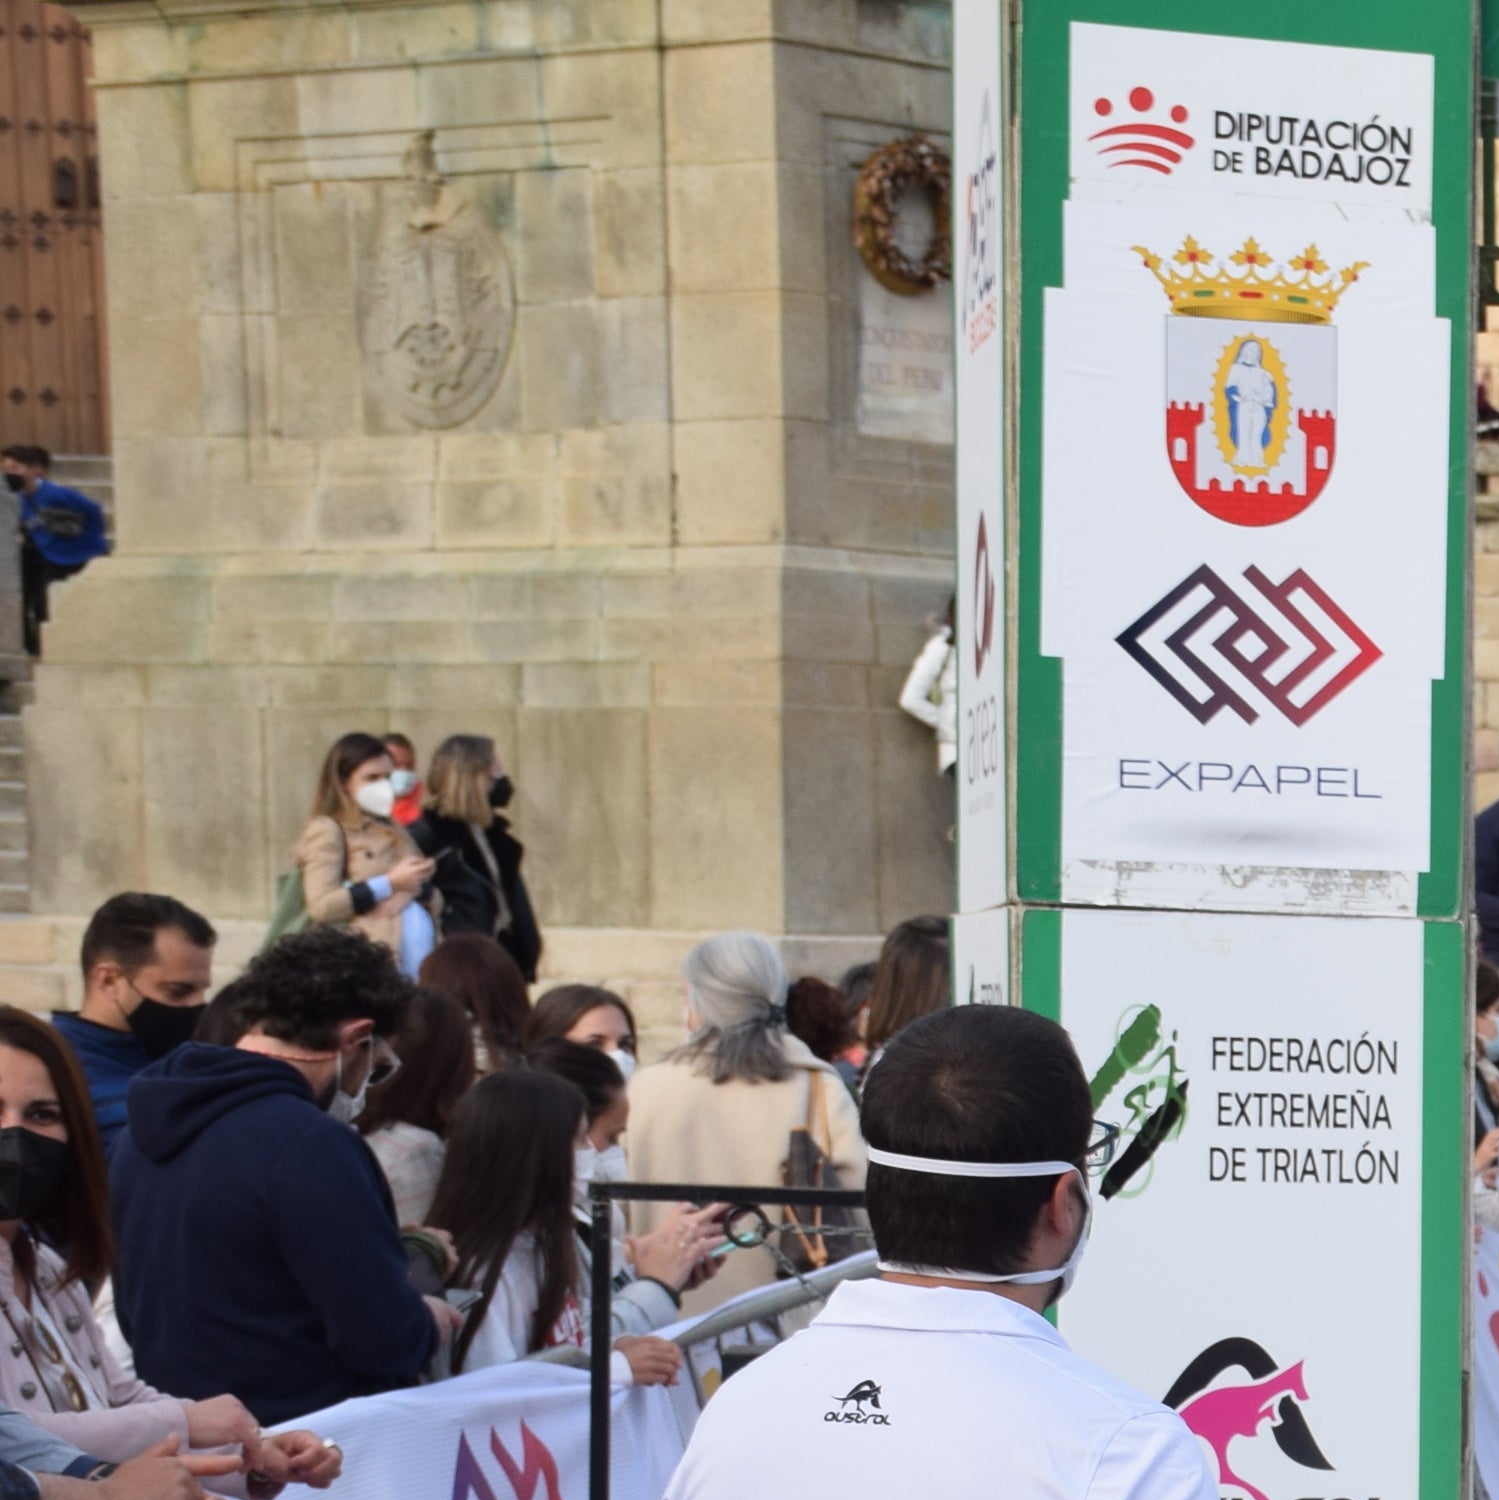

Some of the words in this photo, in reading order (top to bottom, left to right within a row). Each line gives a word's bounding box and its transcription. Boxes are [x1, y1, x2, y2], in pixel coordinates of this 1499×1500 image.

[1213, 110, 1413, 156] DIPUTACIÓN
[1213, 150, 1244, 175] DE
[1254, 147, 1411, 188] BADAJOZ
[967, 694, 998, 786] area
[1118, 758, 1383, 799] EXPAPEL
[1211, 1031, 1399, 1075] FEDERACIÓN
[1217, 1090, 1393, 1130] EXTREMEÑA
[1209, 1146, 1247, 1182] DE
[1256, 1141, 1400, 1185] TRIATLÓN
[823, 1410, 892, 1426] austral
